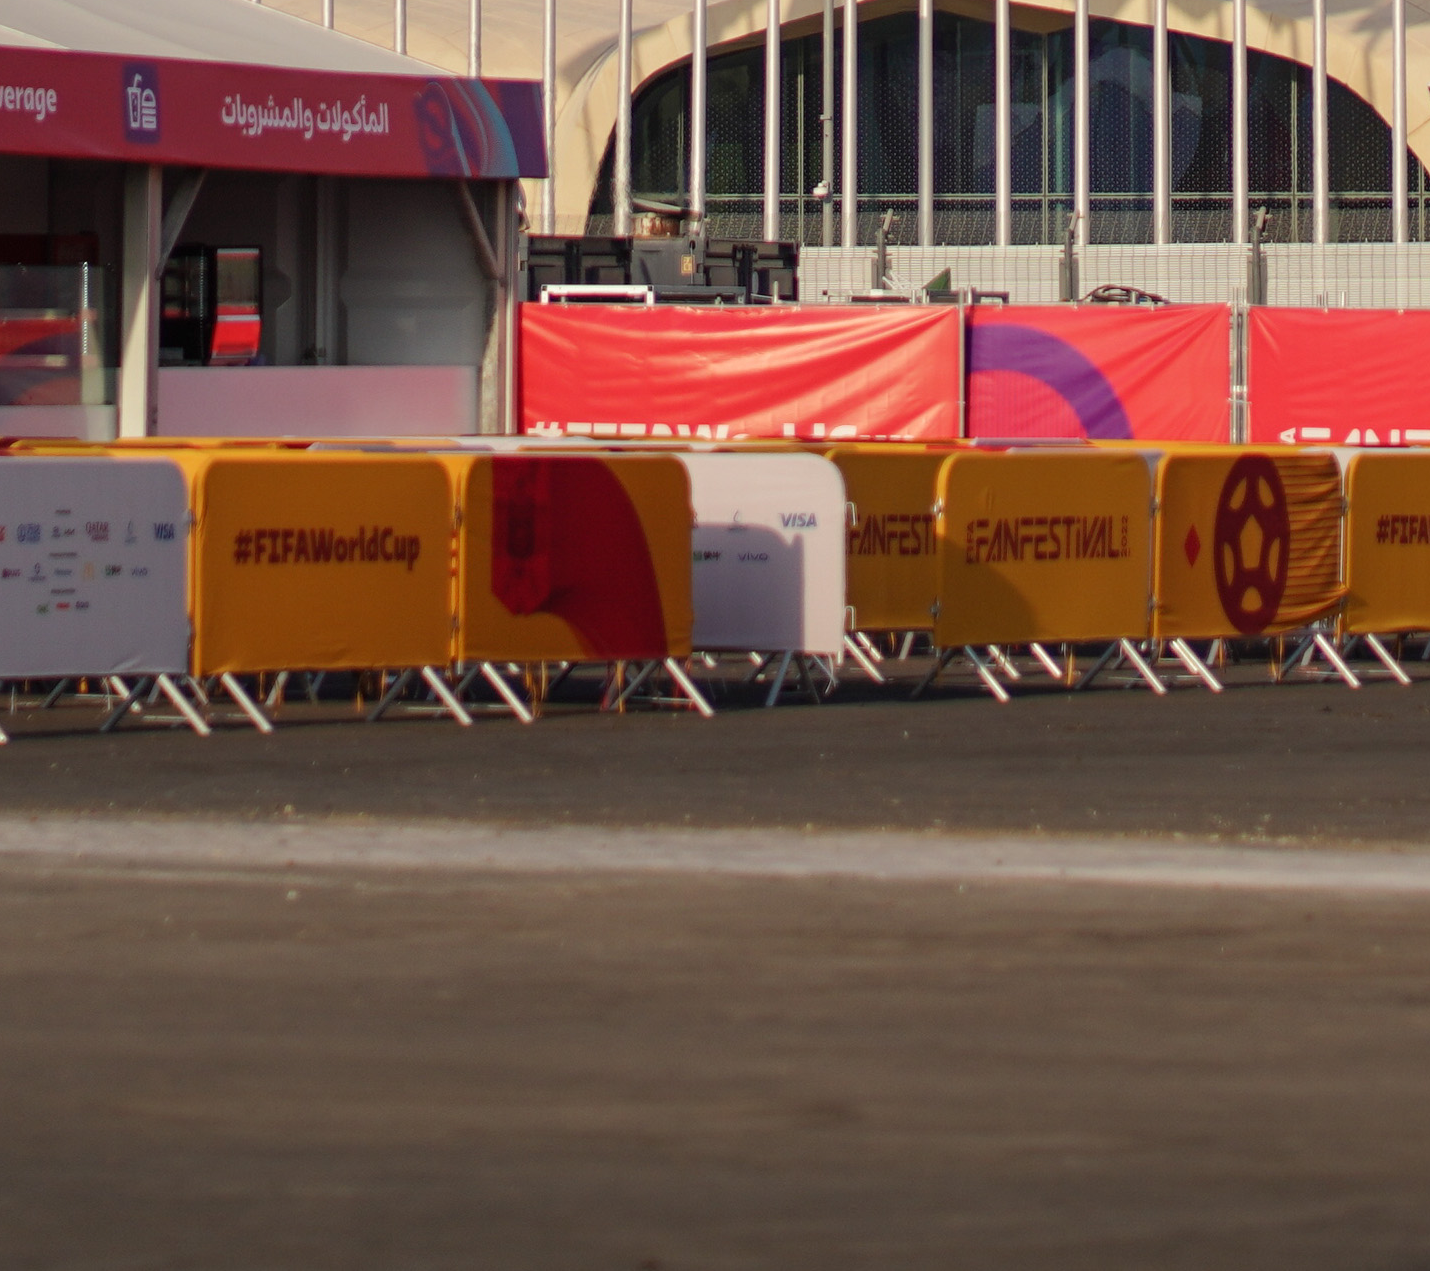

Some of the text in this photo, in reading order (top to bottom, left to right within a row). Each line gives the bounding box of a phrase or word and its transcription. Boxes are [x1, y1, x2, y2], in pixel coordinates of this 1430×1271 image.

[221, 94, 389, 139] المأكولات والمشروبات
[780, 512, 818, 528] VISA
[234, 526, 420, 571] #FIFAWorldCup
[737, 552, 769, 562] vivo
